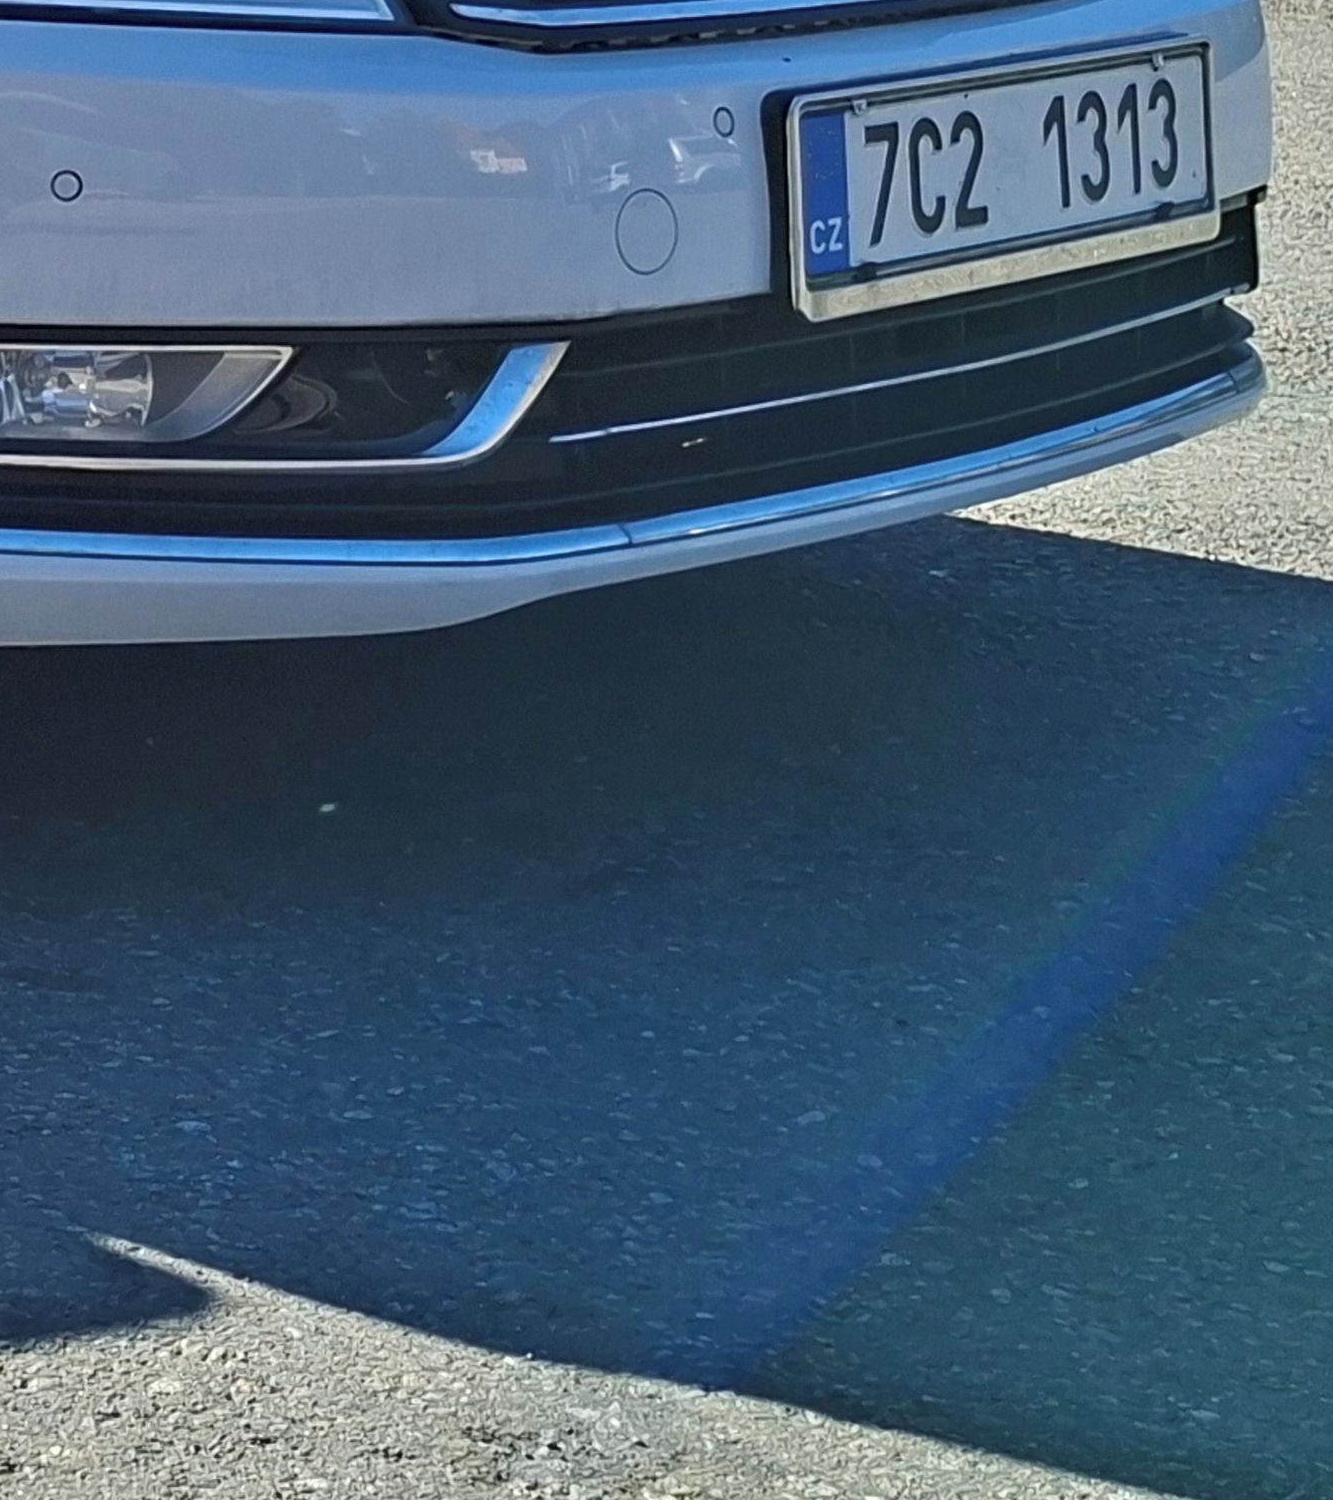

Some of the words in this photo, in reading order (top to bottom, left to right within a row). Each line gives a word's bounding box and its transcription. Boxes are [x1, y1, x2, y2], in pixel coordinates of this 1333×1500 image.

[864, 109, 989, 248] 7C2
[1042, 77, 1179, 209] 1313
[808, 216, 844, 255] CZ
